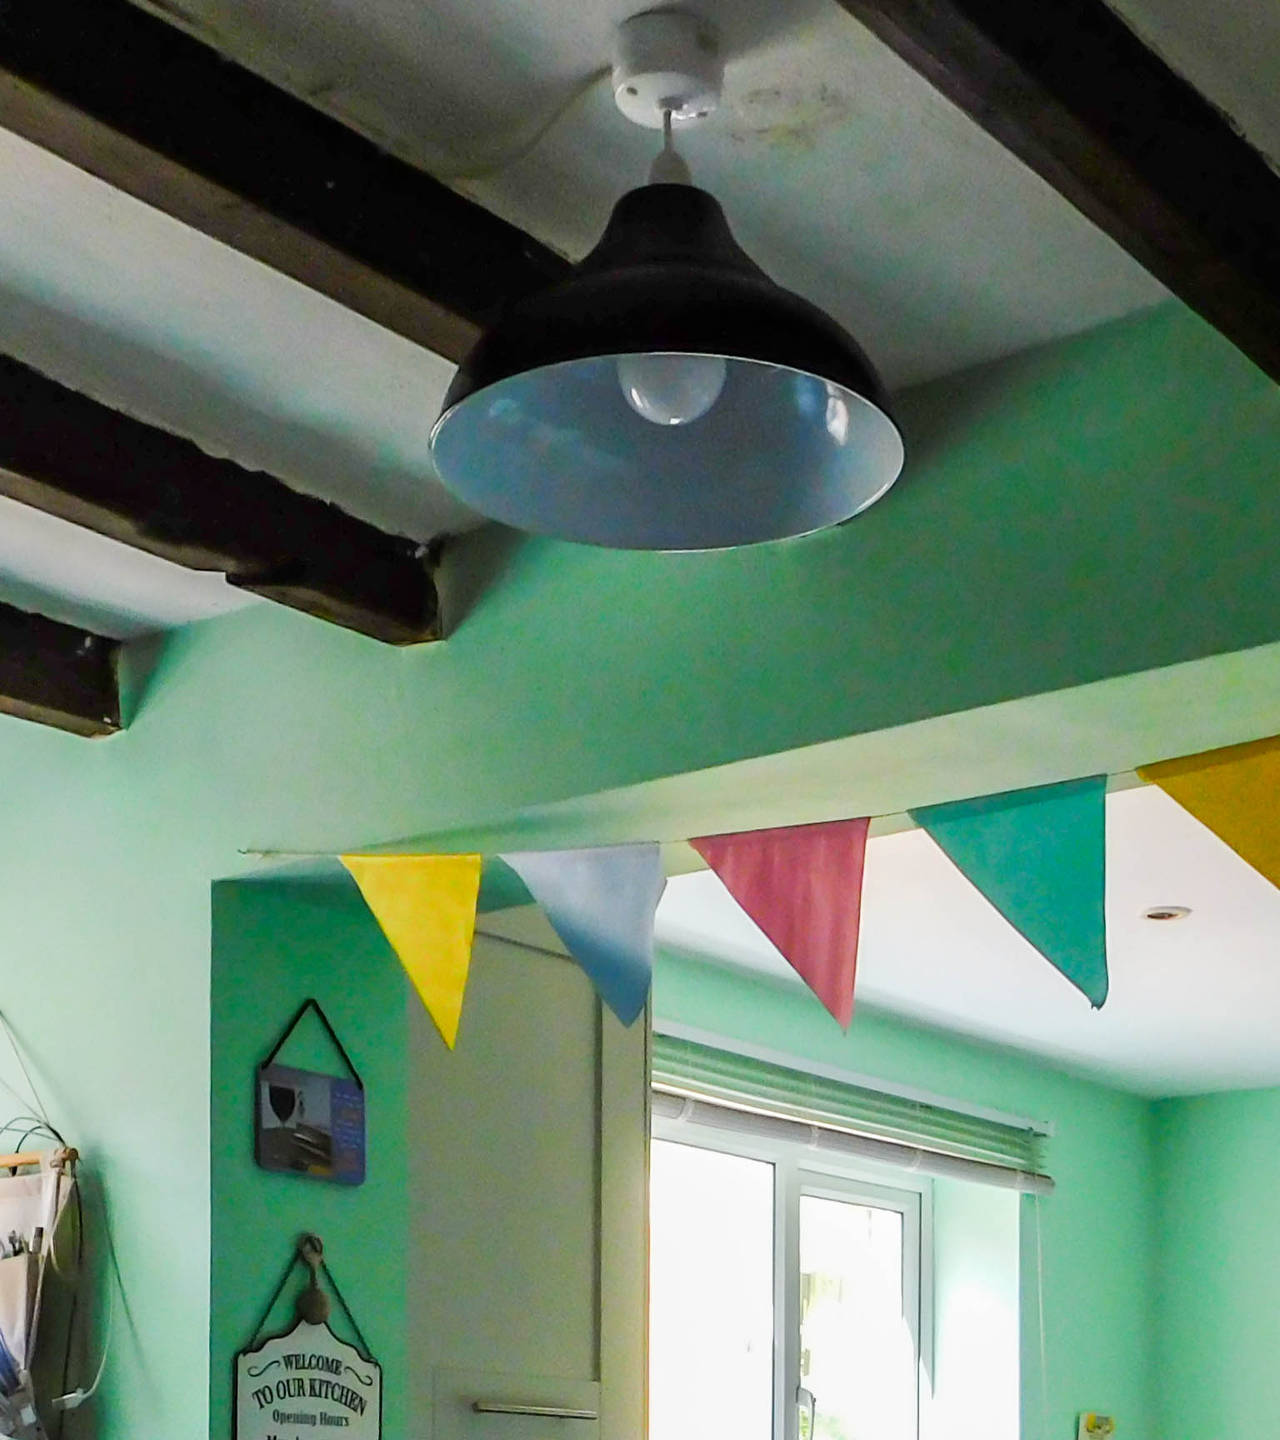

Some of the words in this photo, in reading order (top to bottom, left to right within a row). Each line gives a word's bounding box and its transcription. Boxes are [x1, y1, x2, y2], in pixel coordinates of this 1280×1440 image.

[282, 1354, 342, 1376] WELCOME
[252, 1385, 274, 1409] TO
[276, 1378, 306, 1400] OUR
[308, 1378, 368, 1416] KITCHEN
[273, 1409, 317, 1427] Opening
[319, 1412, 350, 1427] Hours
